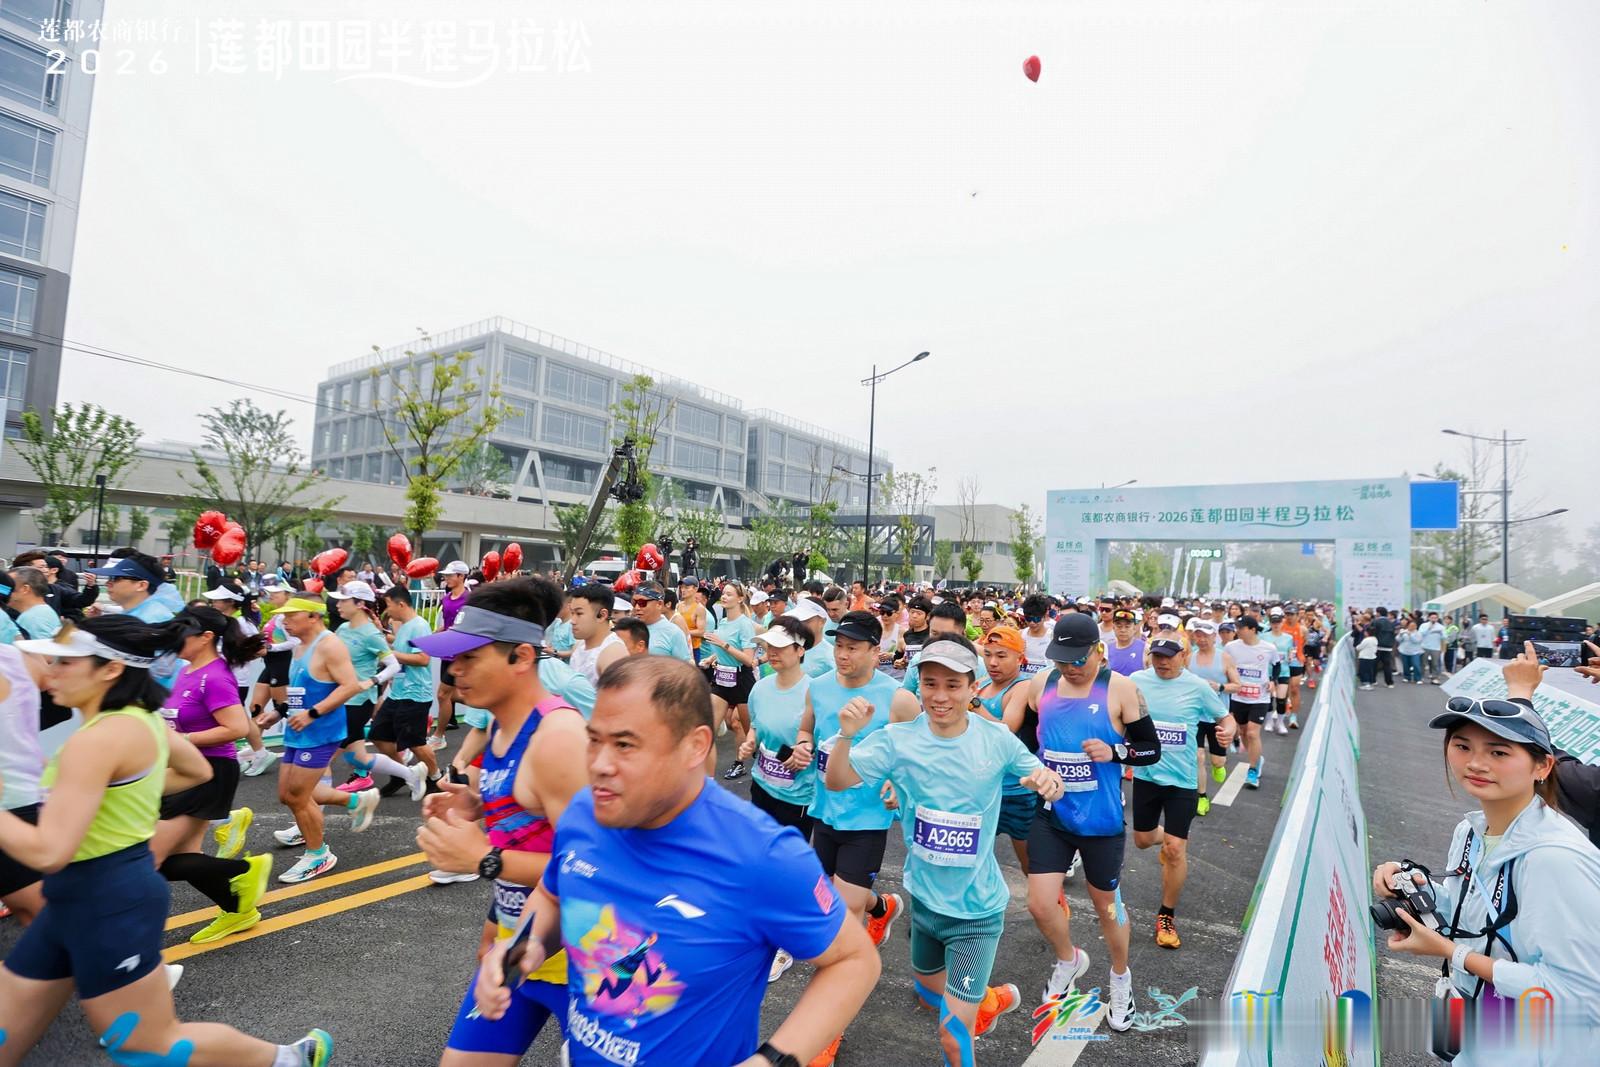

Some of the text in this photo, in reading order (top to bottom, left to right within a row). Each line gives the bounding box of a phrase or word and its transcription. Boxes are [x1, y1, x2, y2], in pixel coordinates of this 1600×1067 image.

[1056, 764, 1092, 778] A2388
[927, 827, 974, 848] A2665
[1461, 837, 1472, 869] SONY
[1493, 873, 1505, 908] SONY
